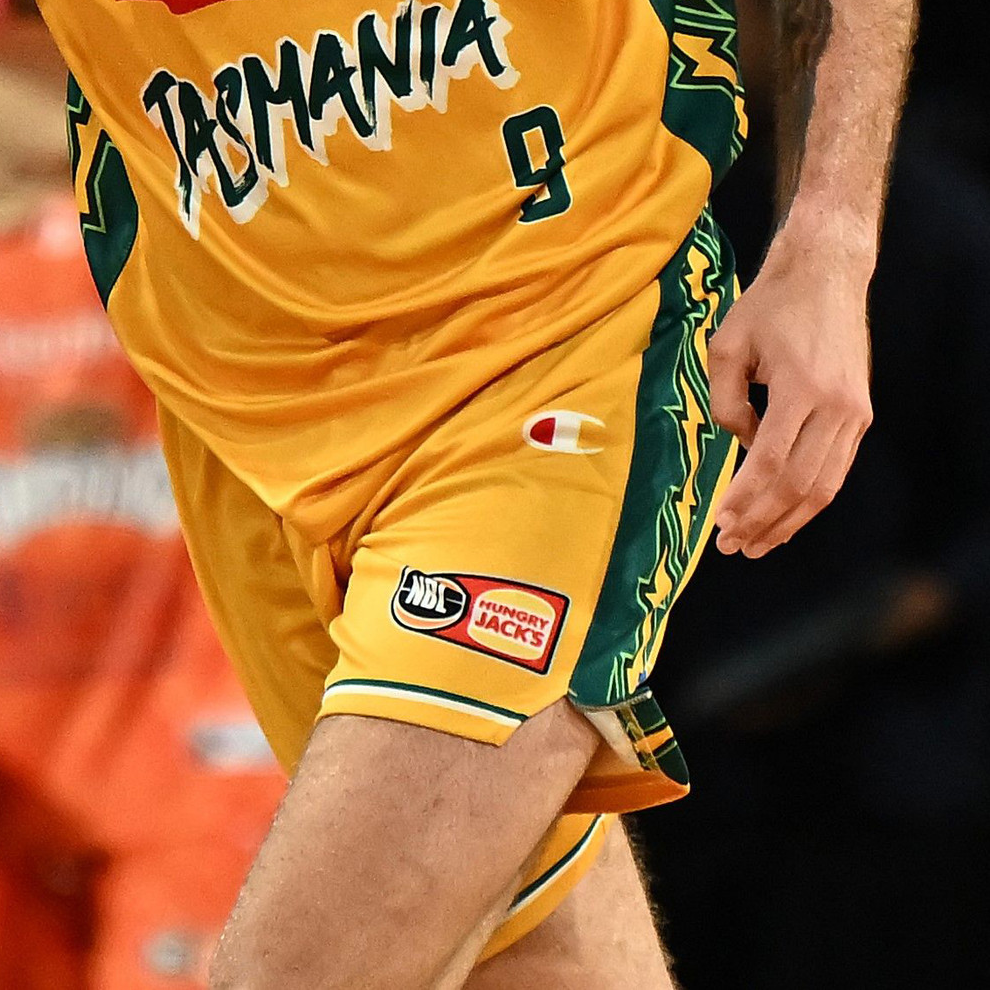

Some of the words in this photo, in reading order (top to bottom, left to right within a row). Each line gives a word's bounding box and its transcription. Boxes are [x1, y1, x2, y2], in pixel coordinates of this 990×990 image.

[502, 104, 573, 224] 9
[405, 575, 447, 614] NBL
[474, 611, 546, 648] JACK'S
[478, 600, 550, 630] HUNGRY
